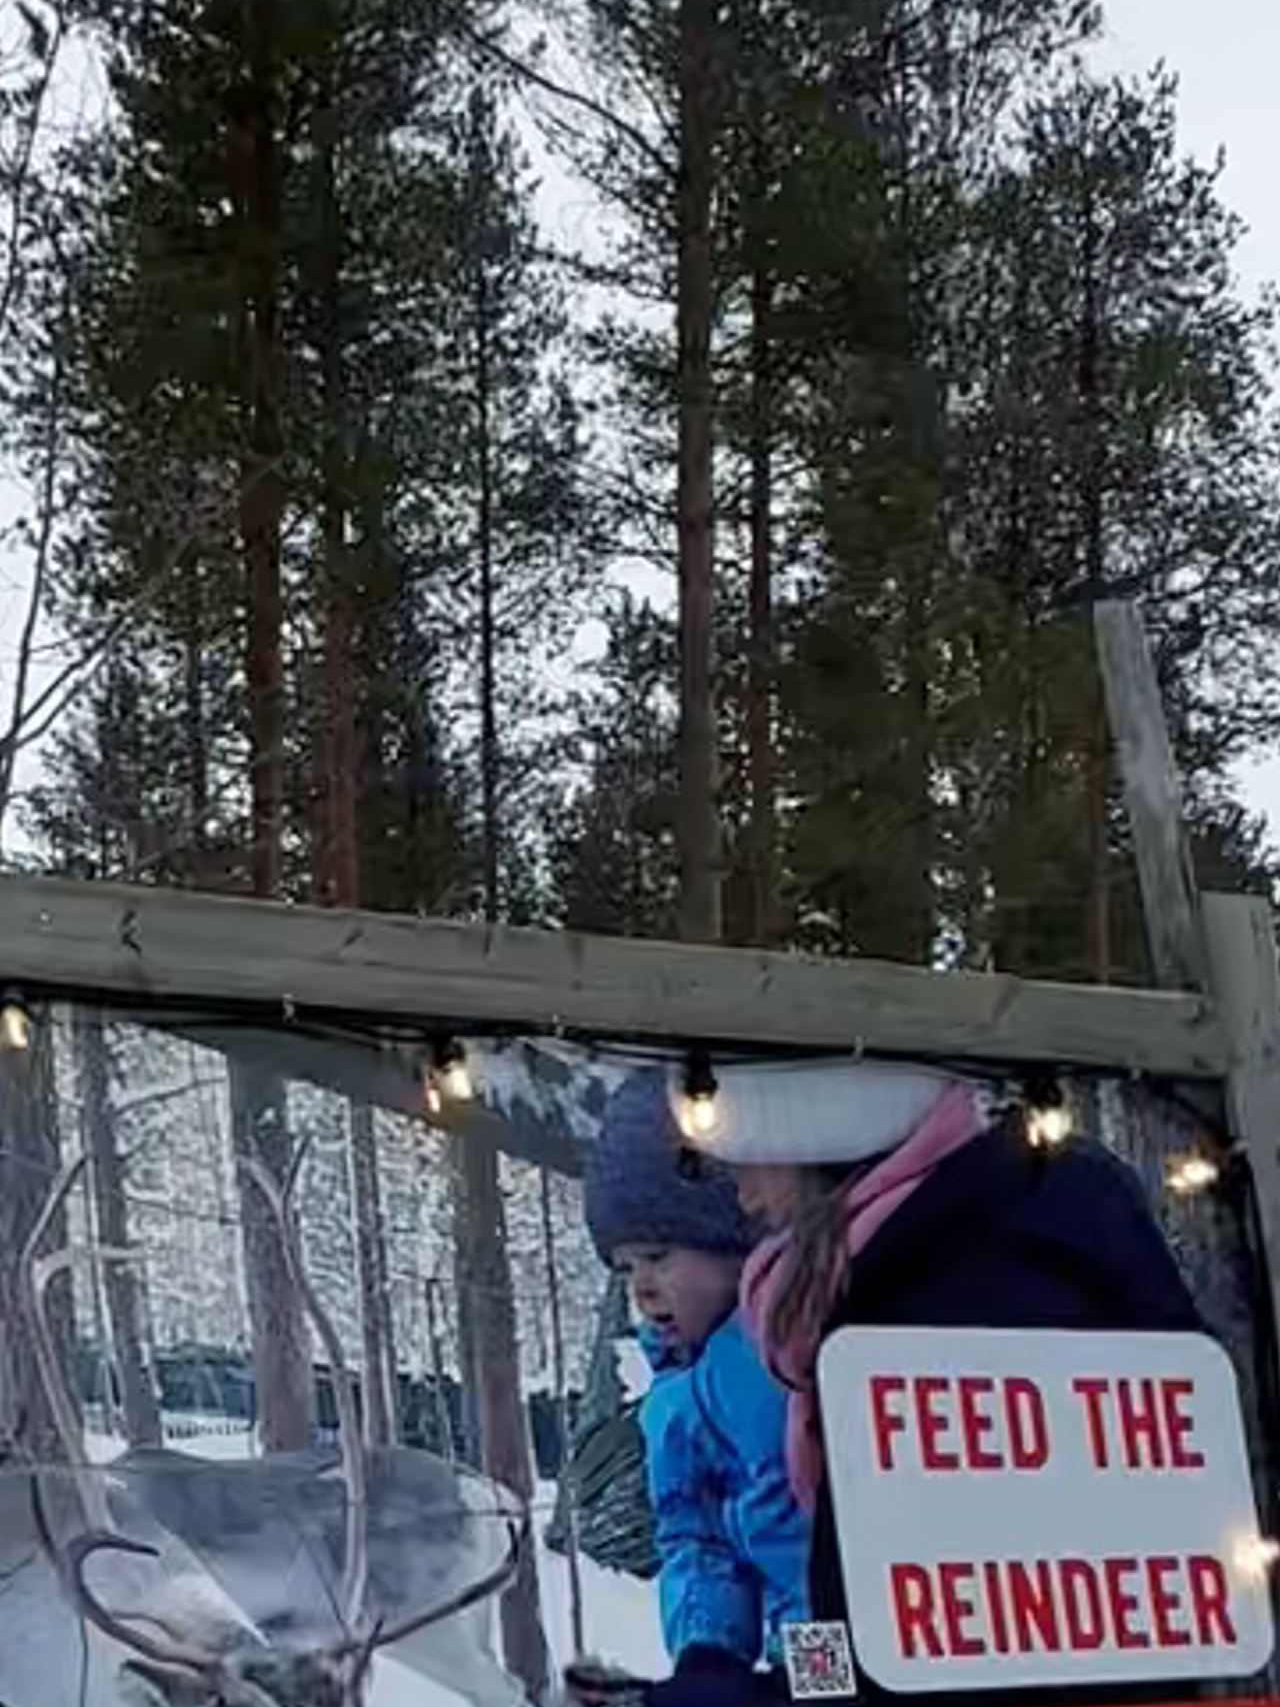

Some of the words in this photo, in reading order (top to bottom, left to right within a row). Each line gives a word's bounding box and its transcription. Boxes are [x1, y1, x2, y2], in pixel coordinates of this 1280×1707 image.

[867, 1375, 1050, 1472] FEED
[1072, 1377, 1205, 1469] THE
[888, 1555, 1238, 1659] REINDEER
